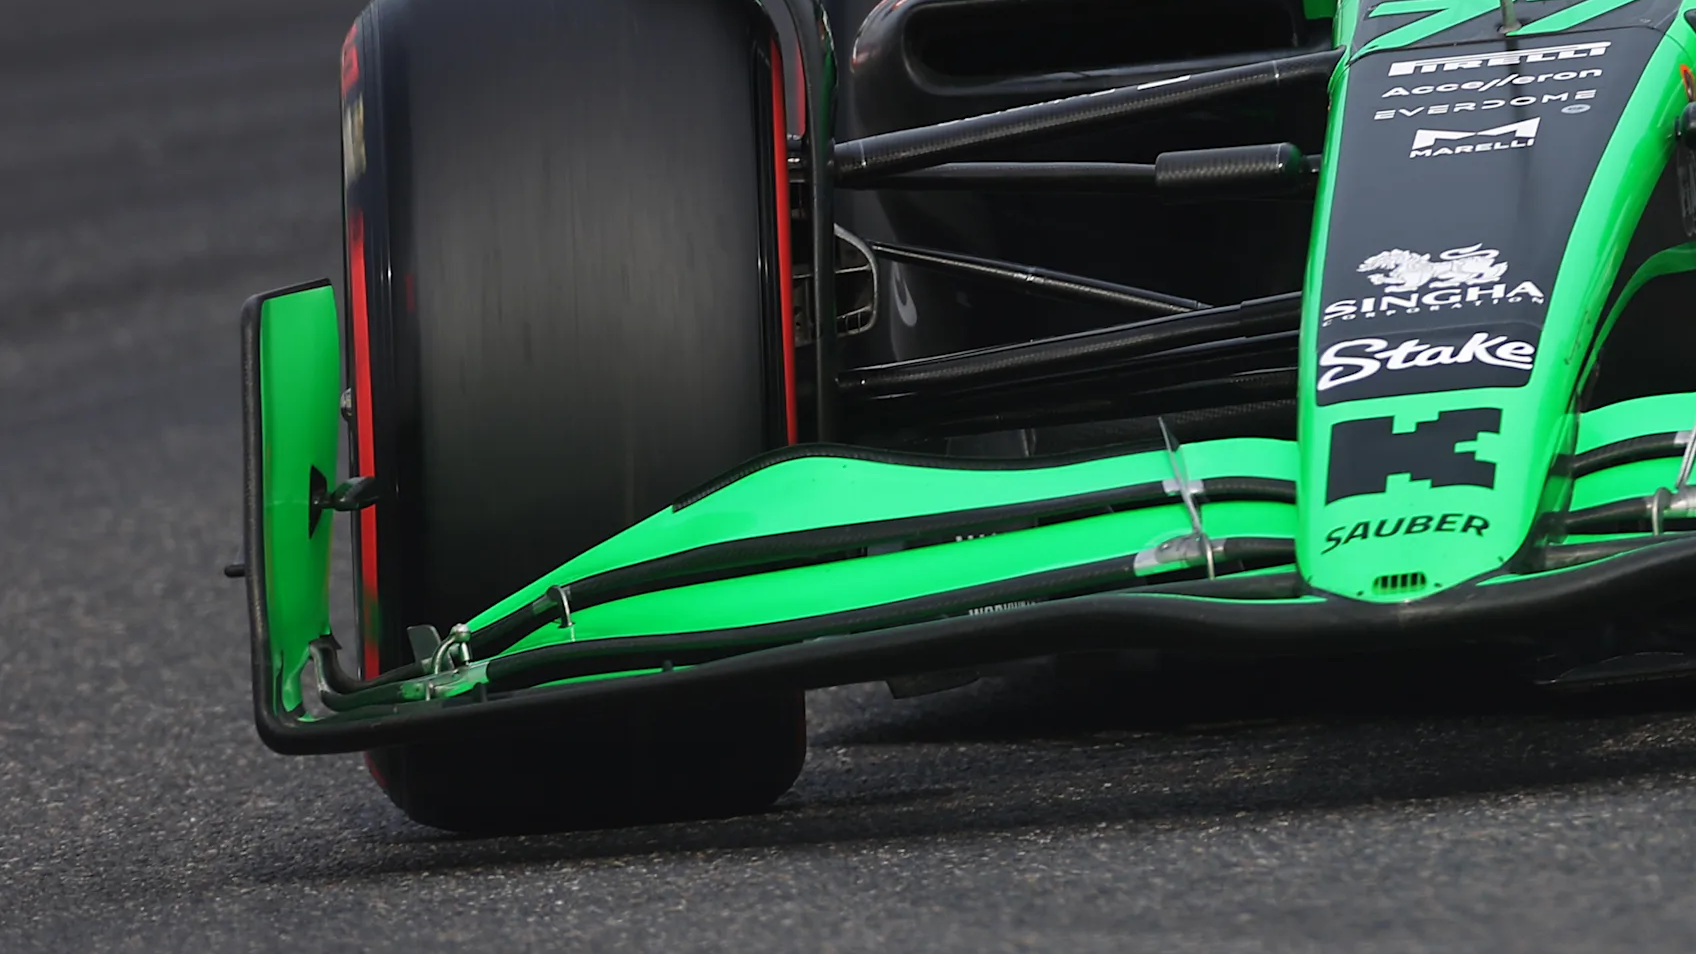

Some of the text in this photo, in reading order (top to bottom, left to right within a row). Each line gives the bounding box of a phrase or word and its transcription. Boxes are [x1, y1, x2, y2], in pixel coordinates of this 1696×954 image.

[1387, 41, 1612, 77] PIRELLI
[1373, 89, 1598, 120] EVERDOME
[1409, 138, 1536, 159] MARELLI
[1323, 281, 1545, 321] SINGHA
[1316, 332, 1536, 391] Stake
[1321, 513, 1490, 556] SAUBER
